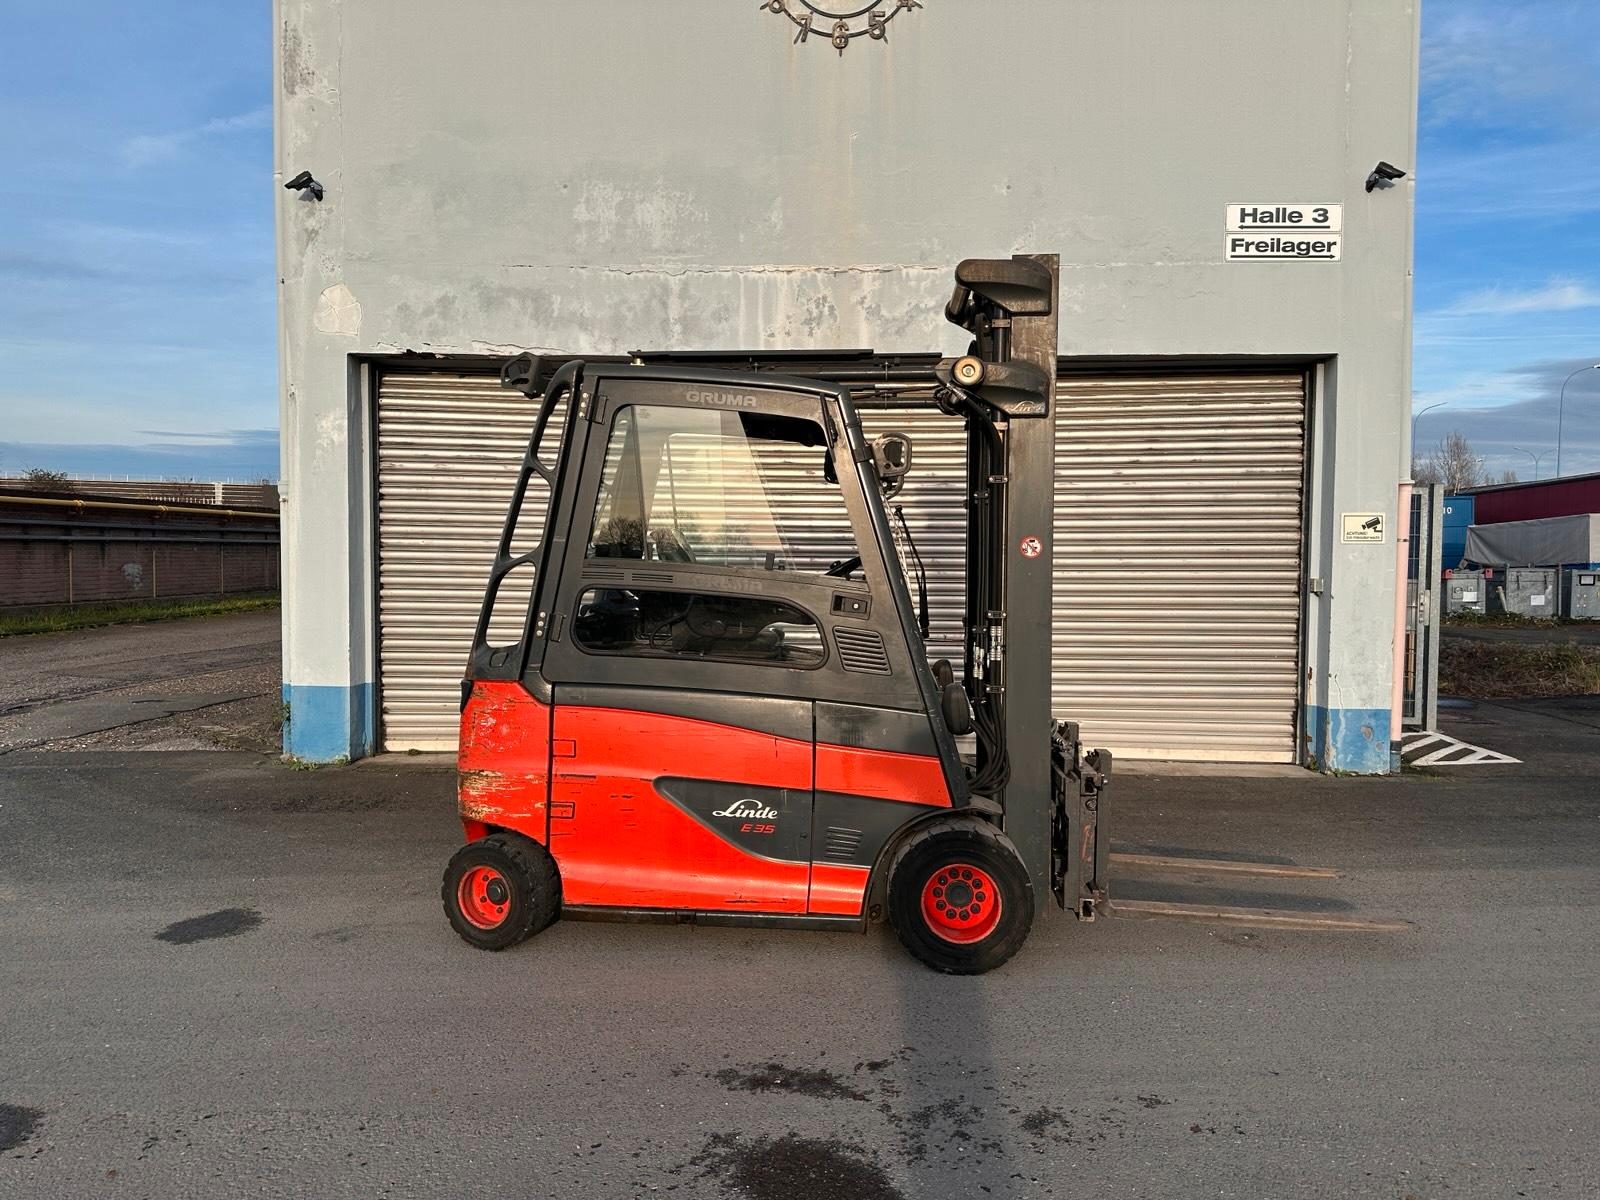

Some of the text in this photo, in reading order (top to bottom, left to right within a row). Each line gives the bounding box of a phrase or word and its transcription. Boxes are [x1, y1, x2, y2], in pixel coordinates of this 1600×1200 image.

[832, 21, 849, 50] 6
[868, 10, 886, 40] 5
[1239, 207, 1329, 224] Halle 3
[1230, 237, 1337, 256] Freilager
[685, 390, 757, 407] GRUMA
[712, 798, 778, 819] Linde
[741, 823, 776, 834] E 35
